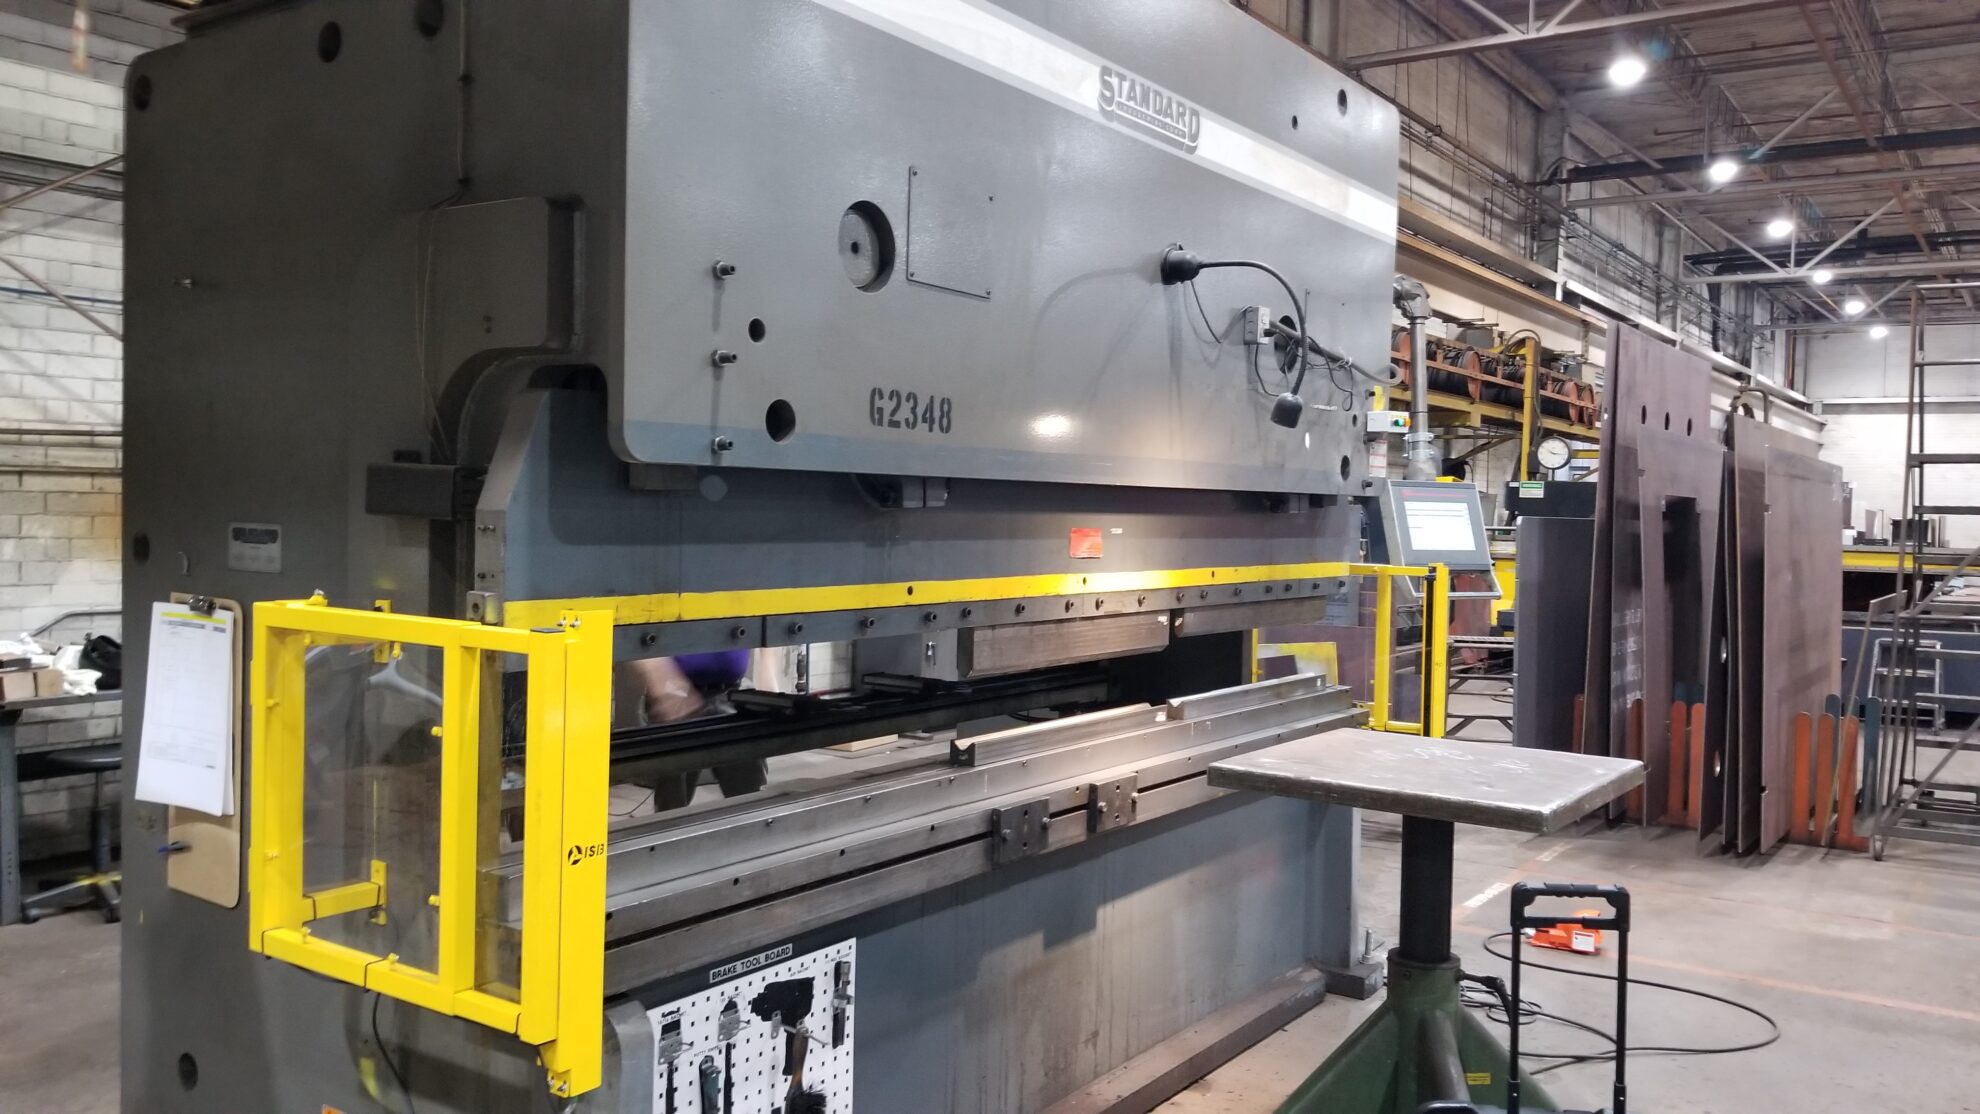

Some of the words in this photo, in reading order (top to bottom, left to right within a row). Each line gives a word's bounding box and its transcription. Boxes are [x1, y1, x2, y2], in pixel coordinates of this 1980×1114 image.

[1100, 64, 1200, 145] STANDARD
[869, 387, 952, 434] G2348
[712, 964, 738, 981] BRAKE
[741, 956, 762, 971] TOOL
[764, 946, 791, 963] BOARD
